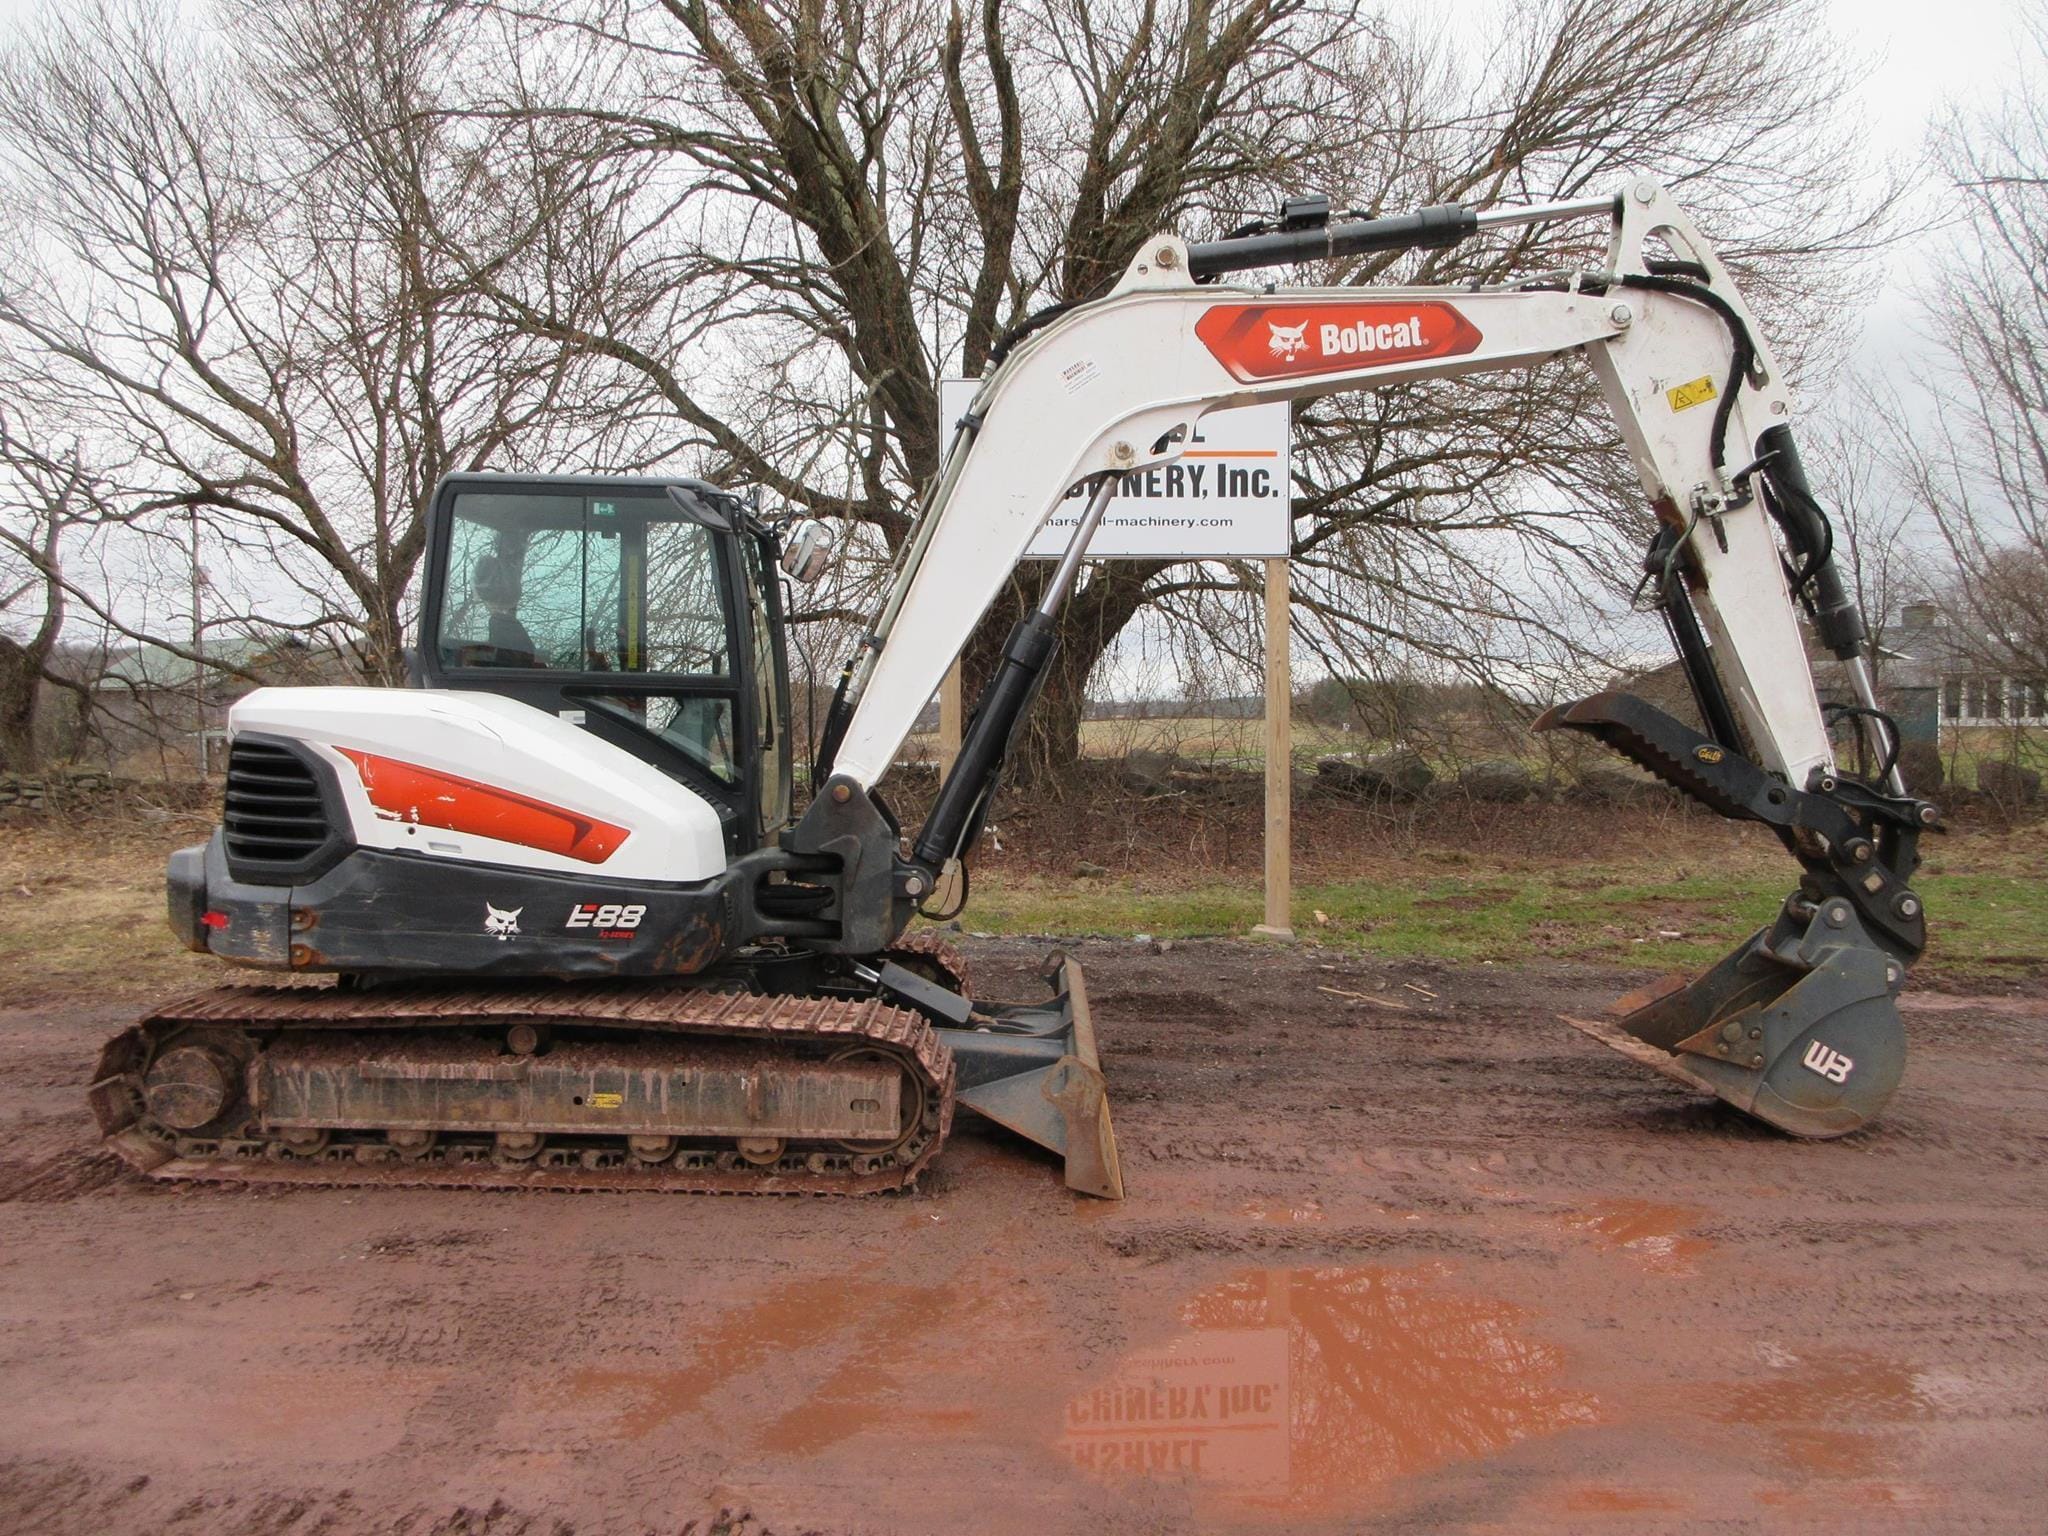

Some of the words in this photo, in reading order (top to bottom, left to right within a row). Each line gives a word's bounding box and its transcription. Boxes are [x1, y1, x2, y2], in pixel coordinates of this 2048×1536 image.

[1320, 317, 1422, 356] Bobcat
[1217, 463, 1279, 498] Inc.
[1045, 516, 1233, 529] arsl-machinery.com
[565, 904, 647, 928] E88
